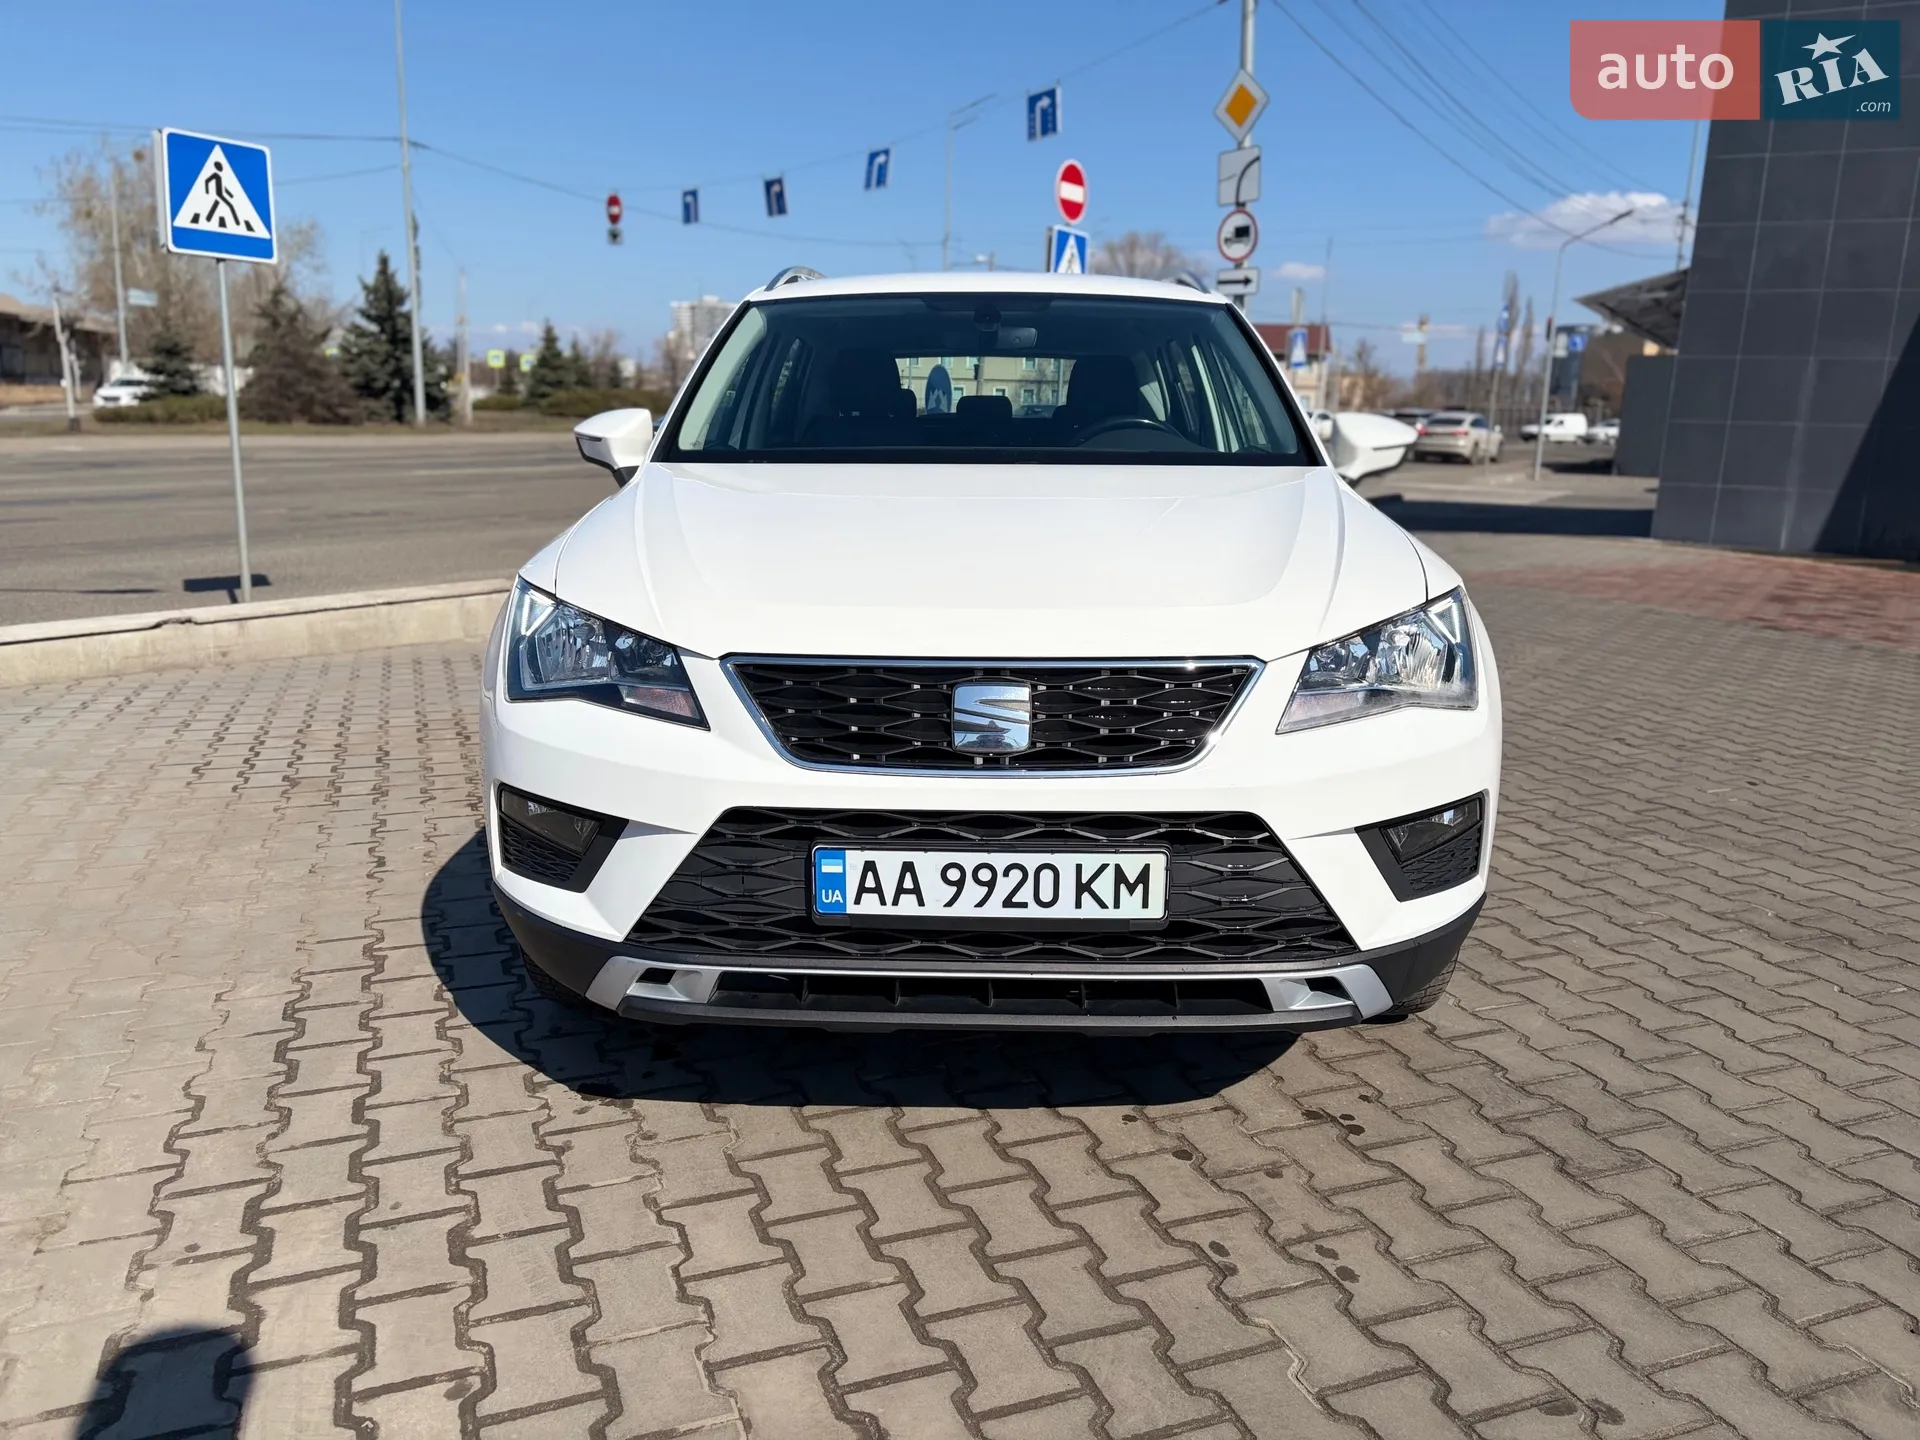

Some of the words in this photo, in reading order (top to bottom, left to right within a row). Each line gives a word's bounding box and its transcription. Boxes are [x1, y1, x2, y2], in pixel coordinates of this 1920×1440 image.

[821, 890, 844, 904] UA
[853, 860, 926, 907] AA
[940, 862, 1060, 909] 9920
[1074, 863, 1152, 910] KM
